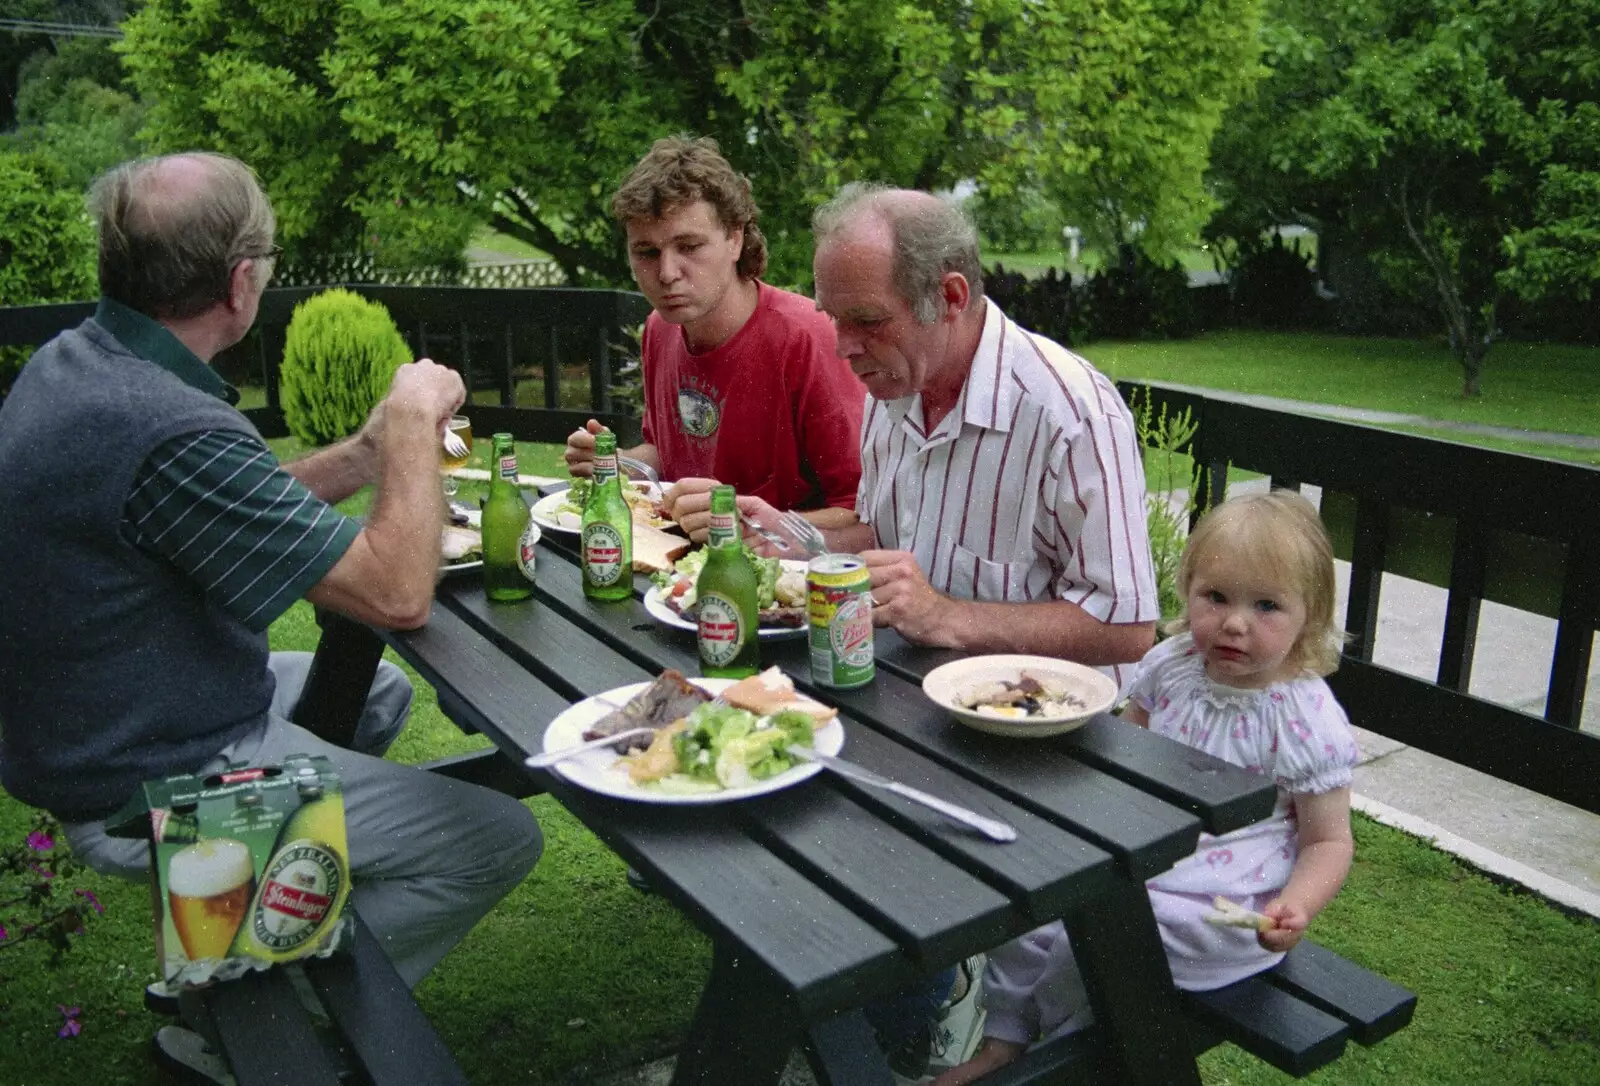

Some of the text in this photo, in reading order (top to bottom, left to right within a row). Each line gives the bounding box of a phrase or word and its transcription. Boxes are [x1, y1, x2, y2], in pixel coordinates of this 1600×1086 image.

[272, 848, 338, 891] NEW ZEALAND
[267, 885, 326, 917] Steinlager
[279, 924, 316, 946] BEER
